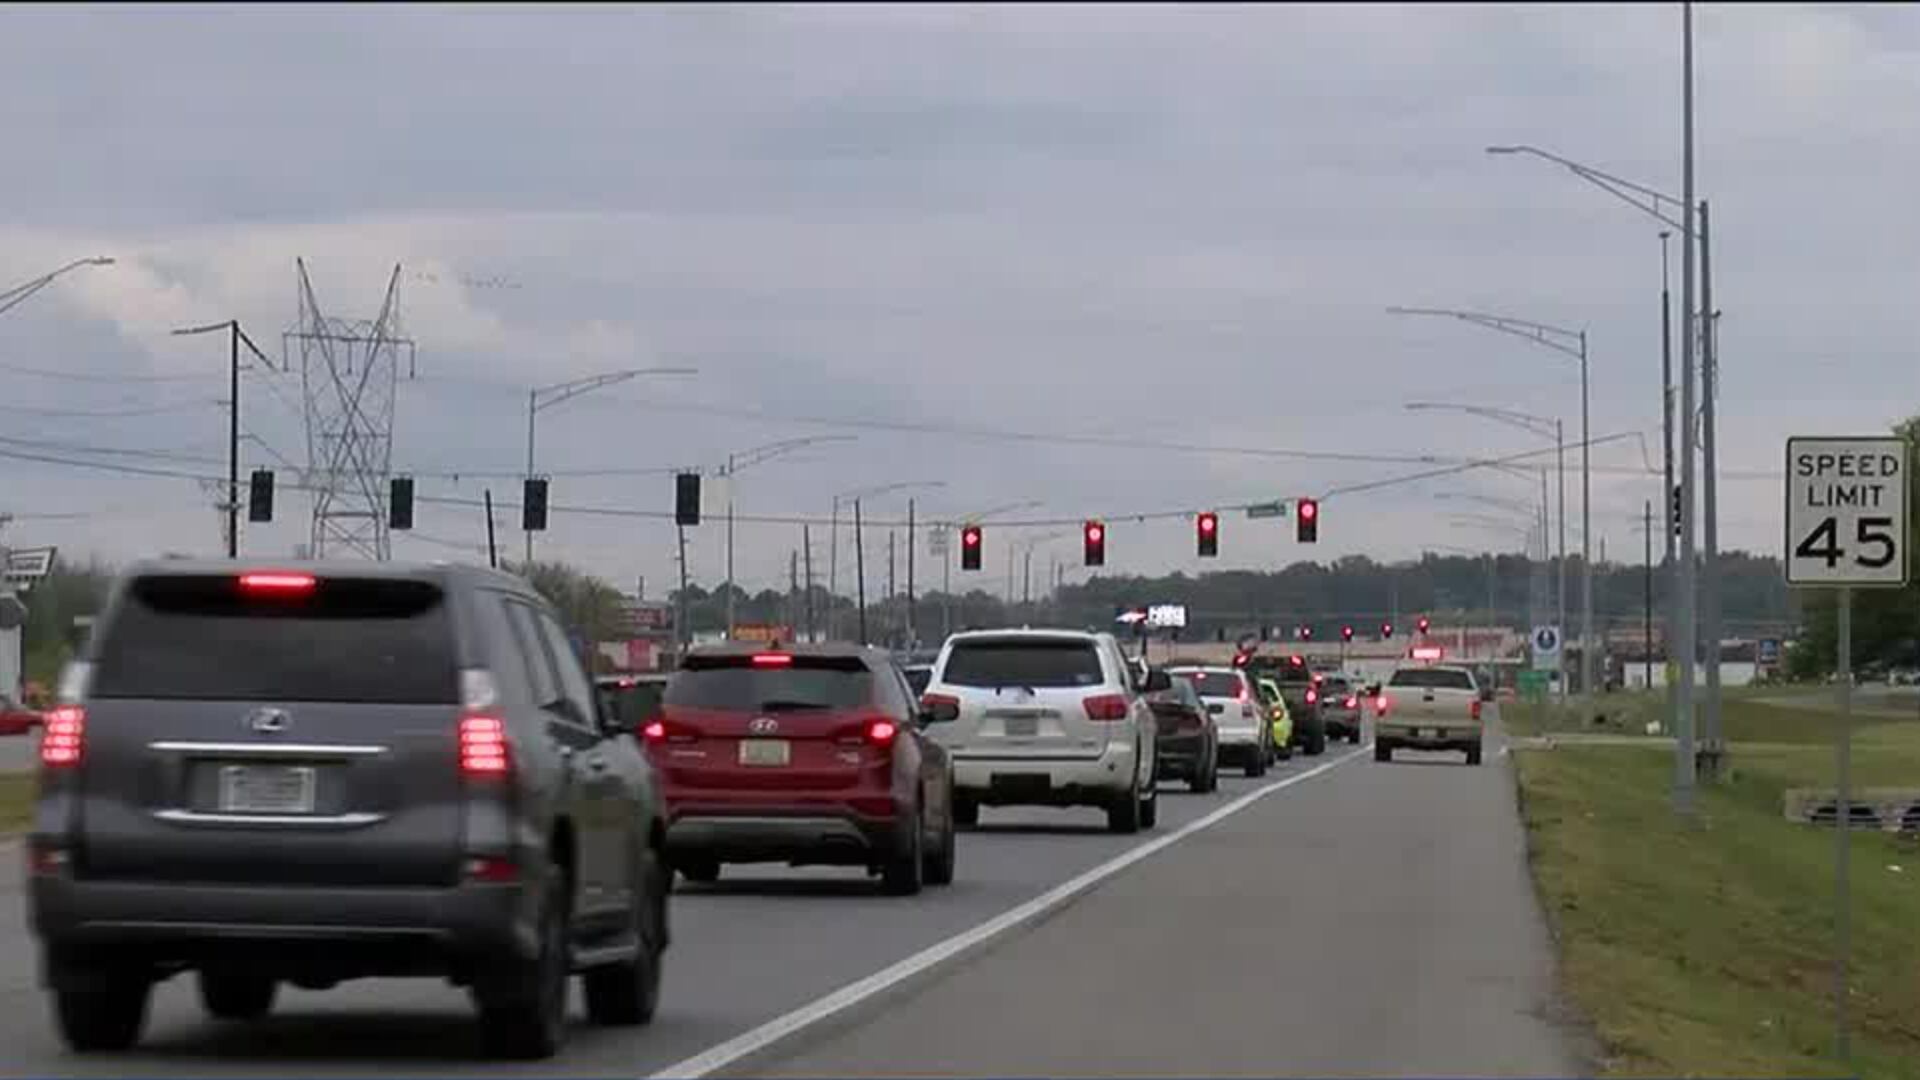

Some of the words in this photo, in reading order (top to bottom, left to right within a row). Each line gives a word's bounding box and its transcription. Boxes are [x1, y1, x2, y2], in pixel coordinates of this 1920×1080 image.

[1797, 454, 1899, 477] SPEED
[1807, 484, 1884, 507] LIMIT
[1795, 516, 1896, 568] 45
